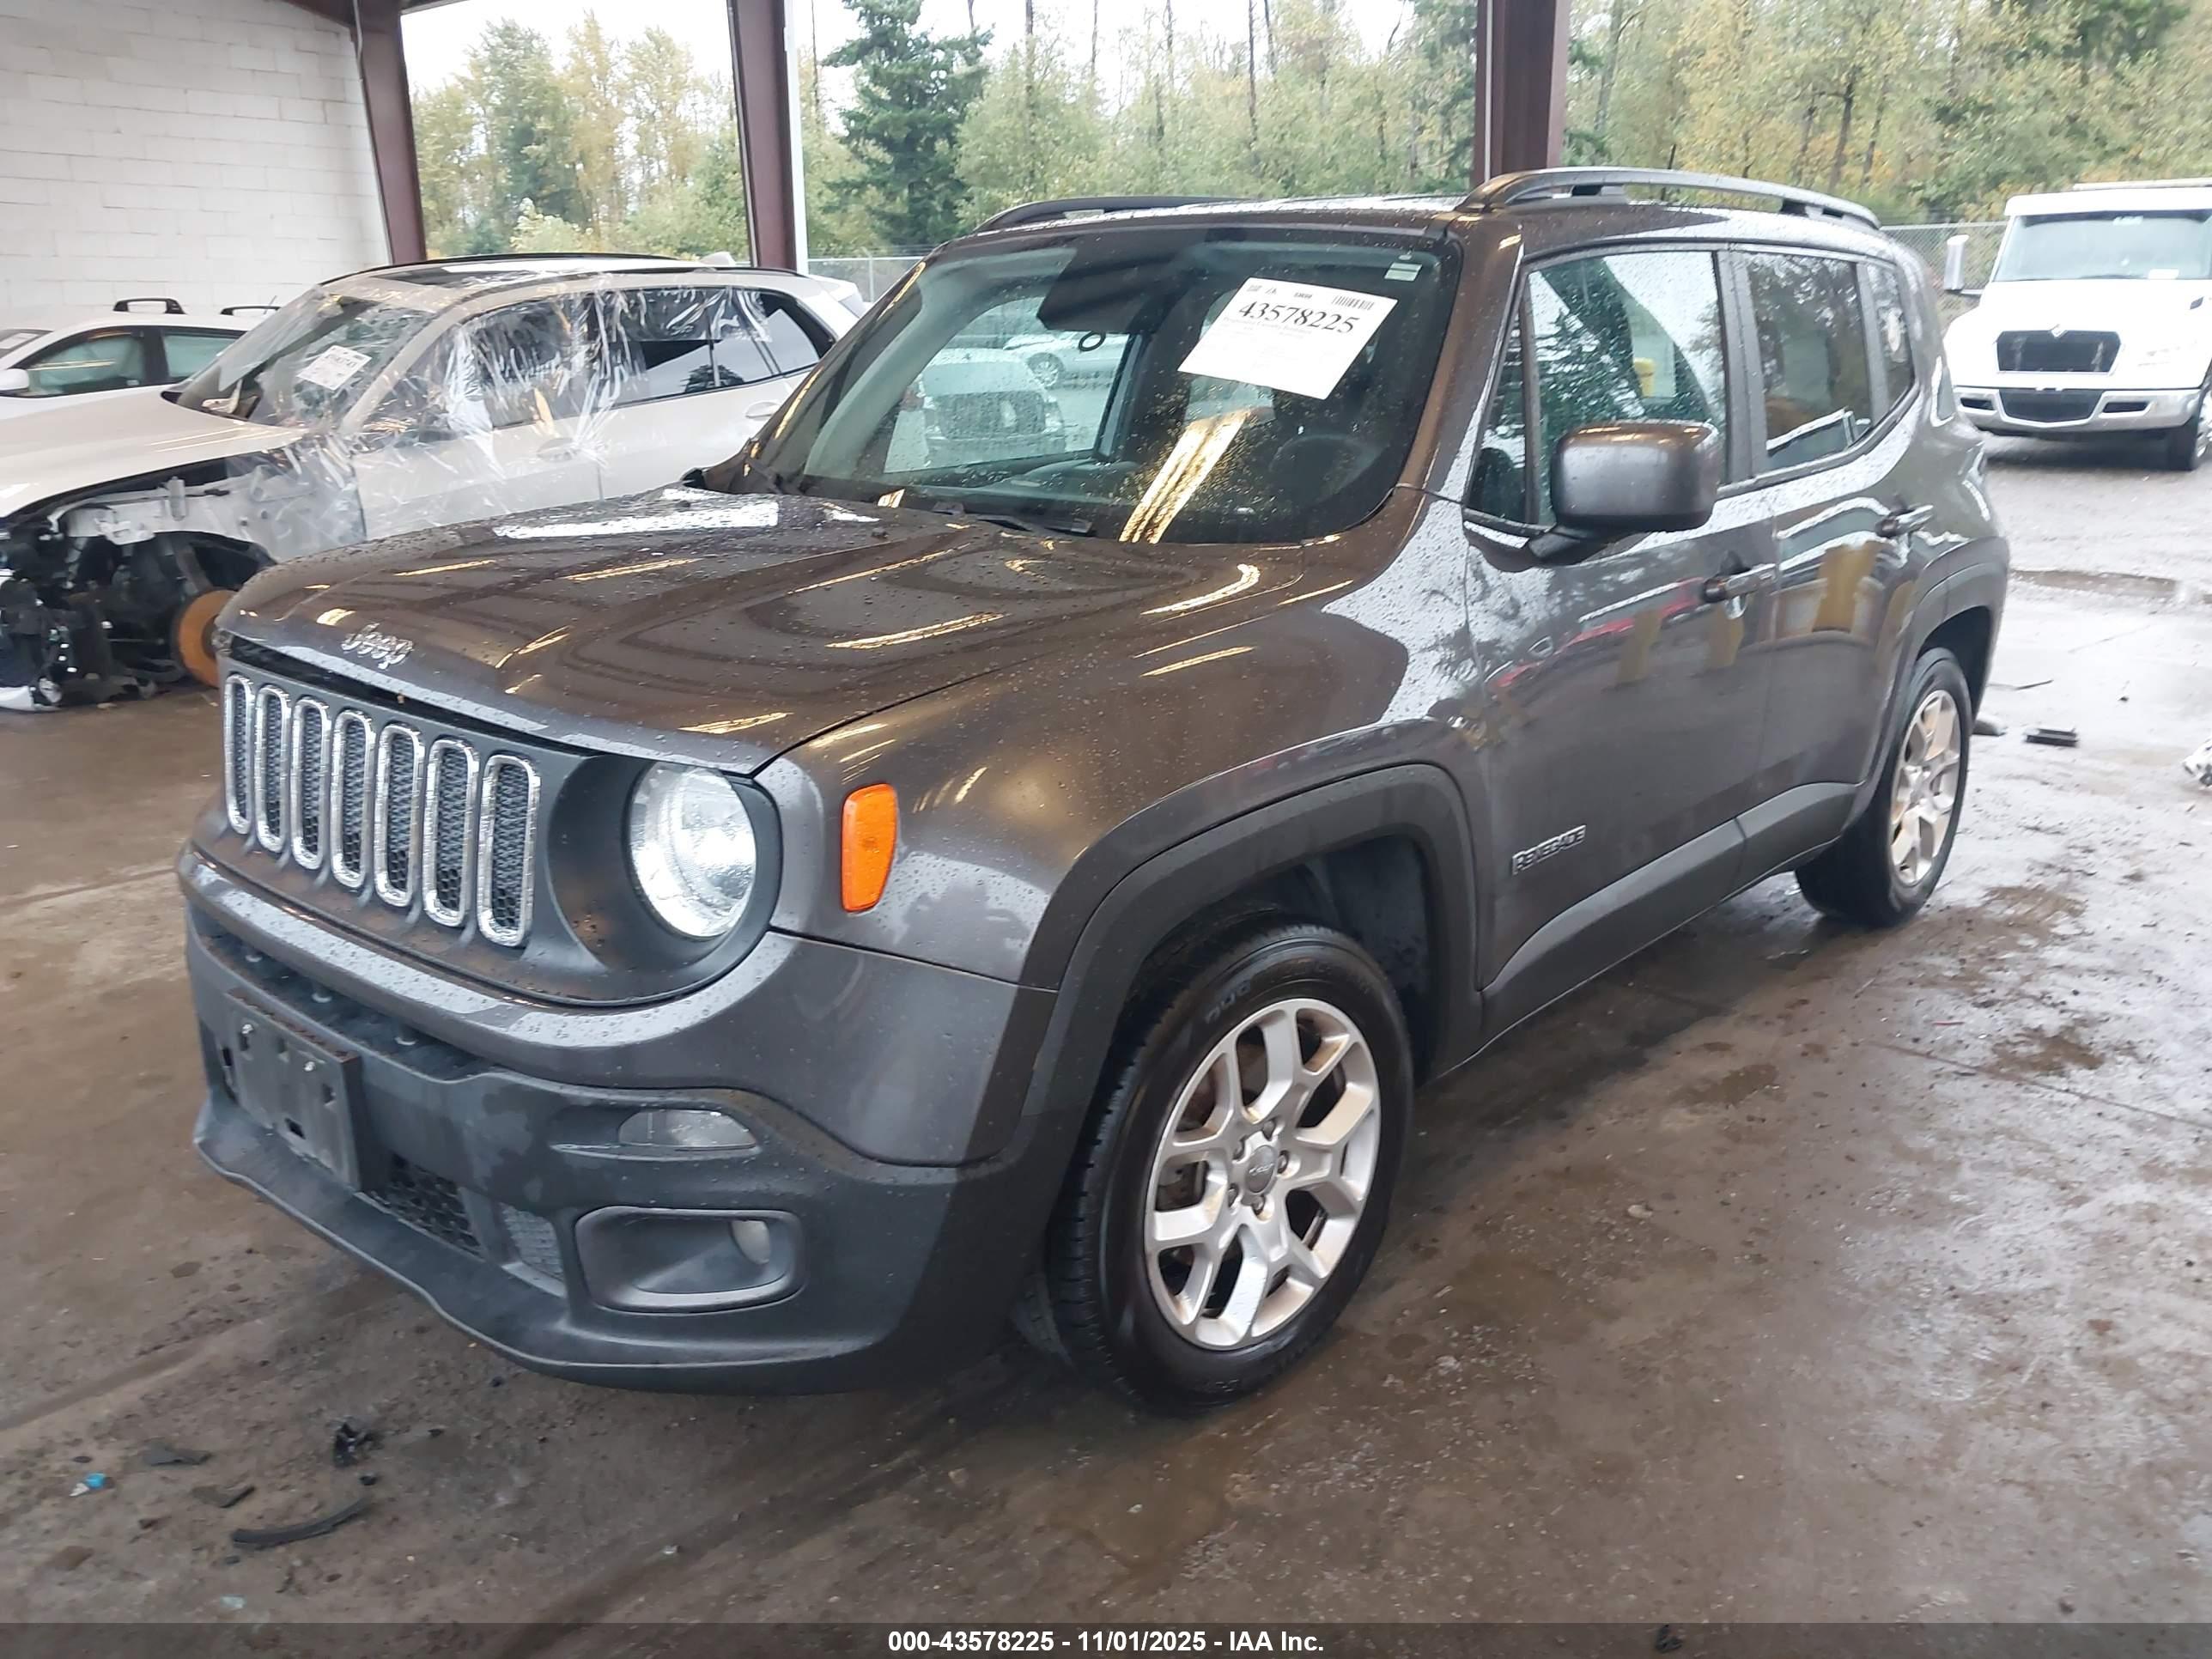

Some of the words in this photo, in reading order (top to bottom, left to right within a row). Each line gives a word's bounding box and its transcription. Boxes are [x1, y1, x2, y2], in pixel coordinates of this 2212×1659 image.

[1238, 301, 1359, 334] 43578225
[342, 623, 413, 670] Jeep
[1512, 824, 1587, 876] RENEGADE
